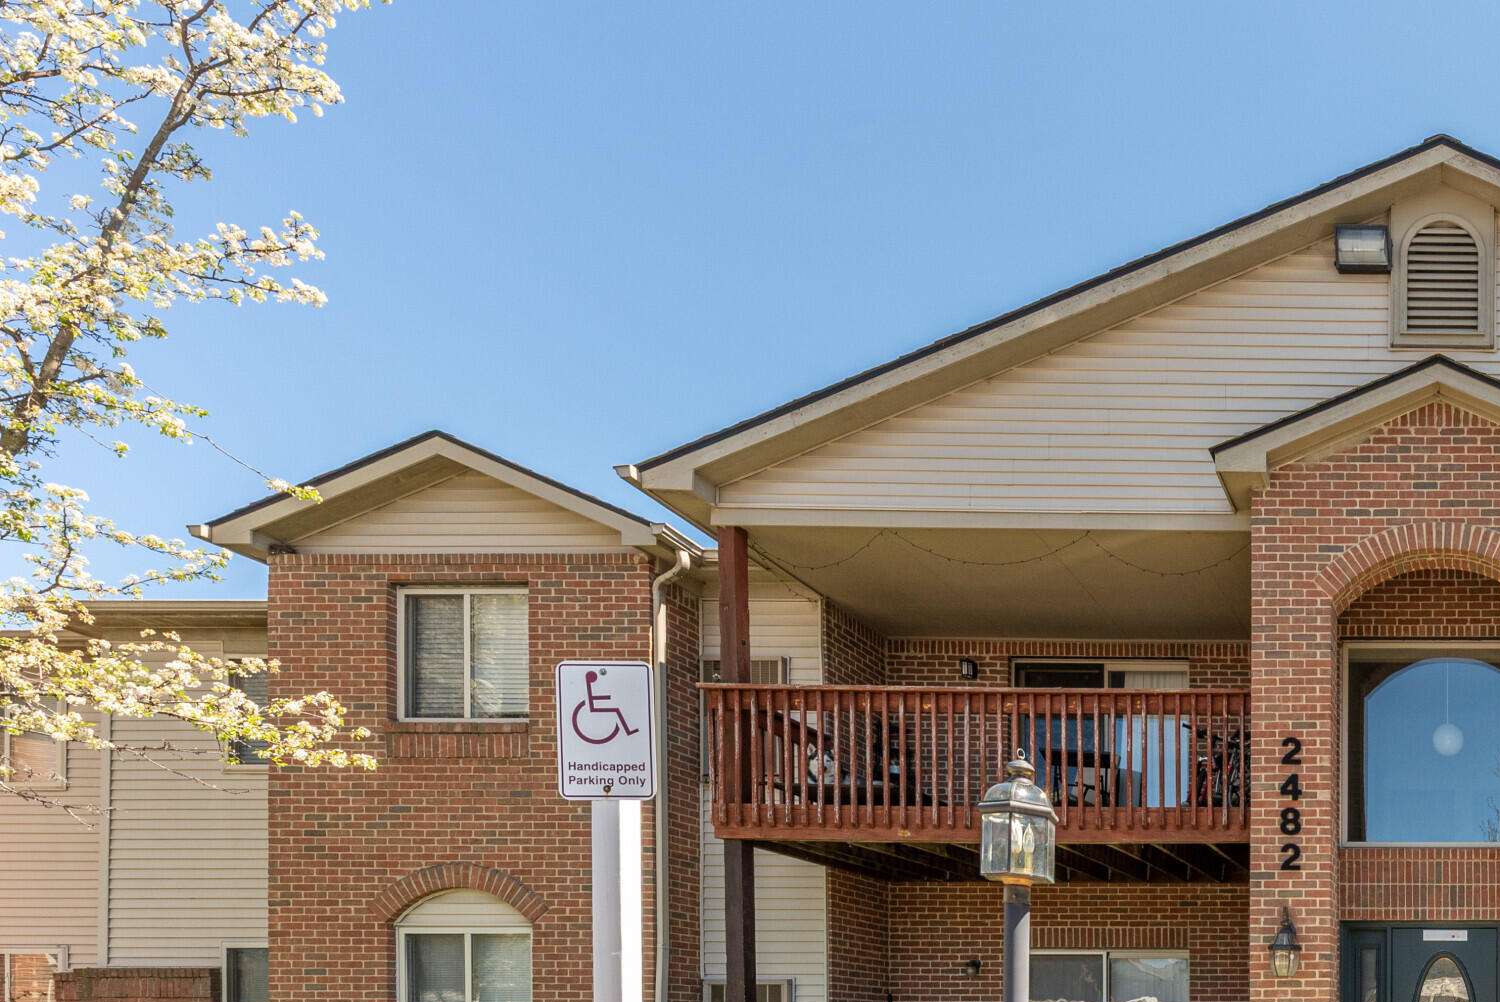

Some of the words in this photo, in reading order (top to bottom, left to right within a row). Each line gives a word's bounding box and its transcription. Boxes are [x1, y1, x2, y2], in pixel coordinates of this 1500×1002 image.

[568, 761, 646, 774] Handicapped
[568, 776, 614, 788] Parking
[618, 776, 646, 788] Only
[1280, 737, 1302, 871] 2482
